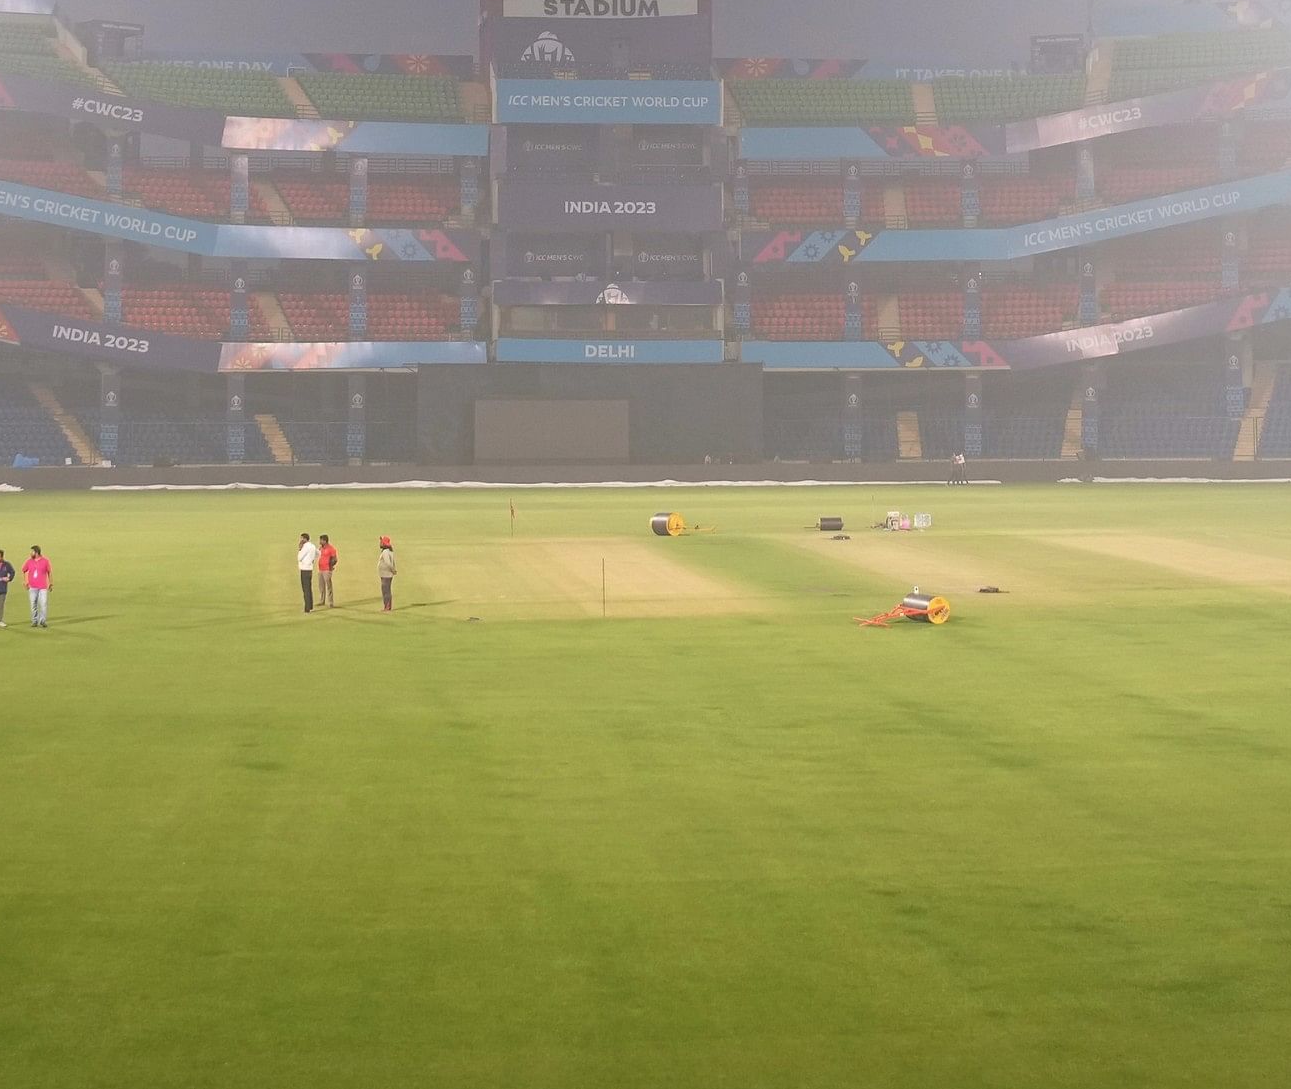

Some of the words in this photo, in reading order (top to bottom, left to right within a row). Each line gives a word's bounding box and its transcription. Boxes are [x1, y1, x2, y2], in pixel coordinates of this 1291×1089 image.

[544, 0, 659, 17] STADIUM
[238, 61, 274, 72] DAY
[895, 68, 910, 79] IT
[71, 97, 144, 123] #CWC23
[508, 95, 528, 106] ICC
[531, 95, 571, 107] MEN'S
[573, 95, 628, 107] CRICKET
[631, 96, 680, 108] WORLD
[682, 96, 709, 109] CUP
[1078, 107, 1142, 130] #CWC23
[564, 201, 612, 214] INDIA
[613, 201, 657, 215] 2023
[33, 197, 101, 224] CRICKET
[103, 210, 162, 237] WORLD
[164, 223, 197, 242] CUP
[1024, 230, 1046, 247] ICC
[1049, 222, 1093, 241] MEN'S
[1095, 209, 1154, 233] CRICKET
[1157, 197, 1210, 219] WORLD
[1212, 191, 1241, 208] CUP
[52, 325, 101, 346] INDIA
[104, 334, 150, 353] 2023
[1066, 335, 1111, 352] INDIA
[1114, 325, 1154, 344] 2023
[584, 344, 635, 358] DELHI
